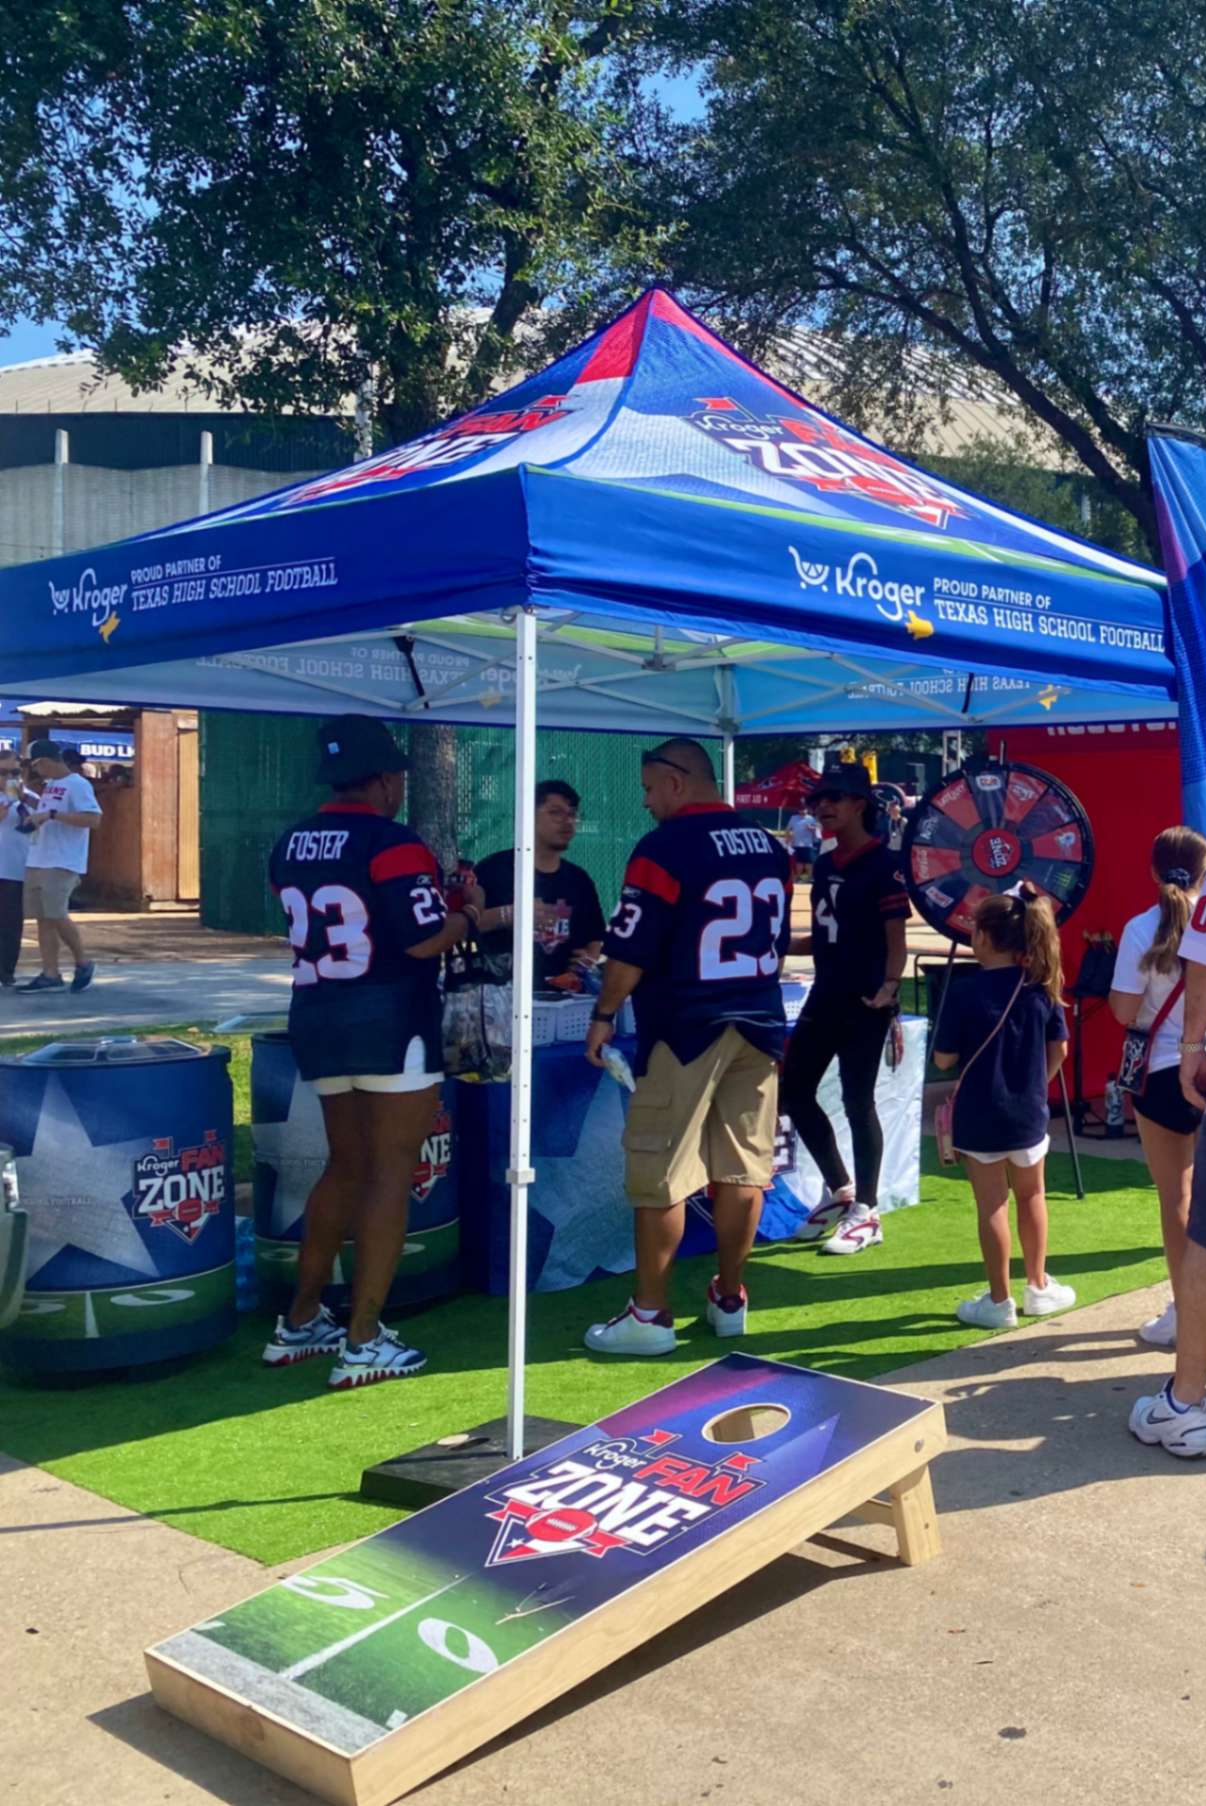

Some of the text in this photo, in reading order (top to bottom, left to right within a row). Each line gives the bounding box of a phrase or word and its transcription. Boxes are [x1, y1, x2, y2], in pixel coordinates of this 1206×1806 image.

[130, 555, 222, 585] PROUD PARTNER OF
[131, 563, 338, 612] TEXAS HIGH SCHOOL FOOTBALL
[835, 552, 926, 621] Kroger
[933, 577, 1052, 610] PROUD PARTNER OF
[73, 568, 128, 627] Kroger
[934, 599, 1165, 654] TEXAS HIGH SCHOOL FOOTBALL
[79, 743, 116, 757] BUD
[286, 830, 350, 862] FOSTER
[708, 828, 773, 858] FOSTER
[699, 876, 787, 981] 23
[137, 1155, 180, 1177] Kroger
[421, 1132, 452, 1167] NE
[138, 1165, 225, 1214] ZONE
[582, 1442, 756, 1506] Kroger FAN
[504, 1461, 712, 1547] ZONE
